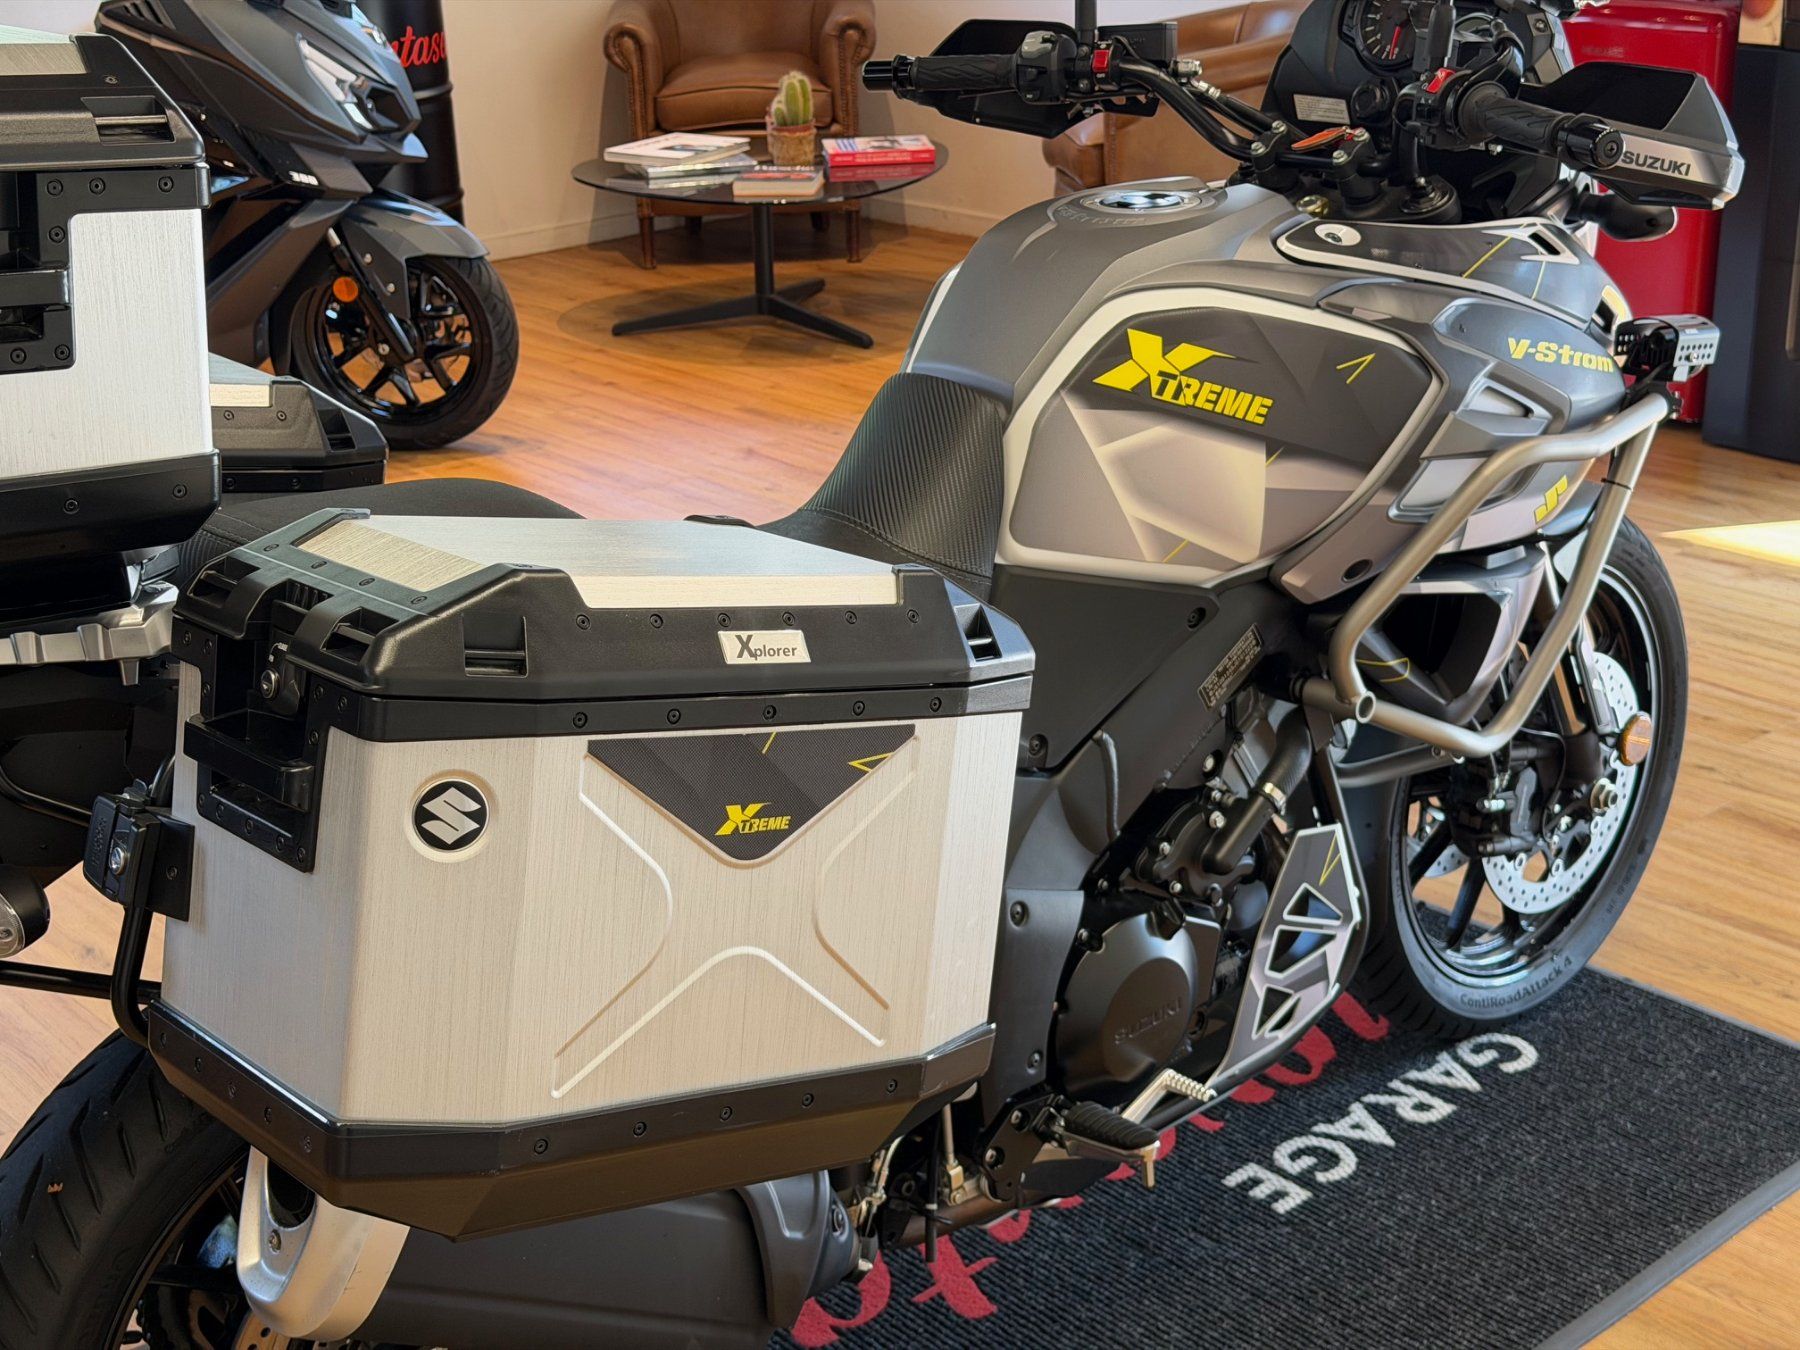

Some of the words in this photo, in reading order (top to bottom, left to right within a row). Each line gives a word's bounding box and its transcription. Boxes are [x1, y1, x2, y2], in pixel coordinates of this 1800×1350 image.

[1621, 150, 1691, 176] SUZUKI
[1507, 337, 1614, 373] V-Strom
[1092, 328, 1274, 425] XTREME
[735, 634, 798, 661] Xplorer
[715, 802, 792, 836] XTREME
[1114, 996, 1182, 1045] SUZUKI
[1221, 1032, 1539, 1214] GARAGE
